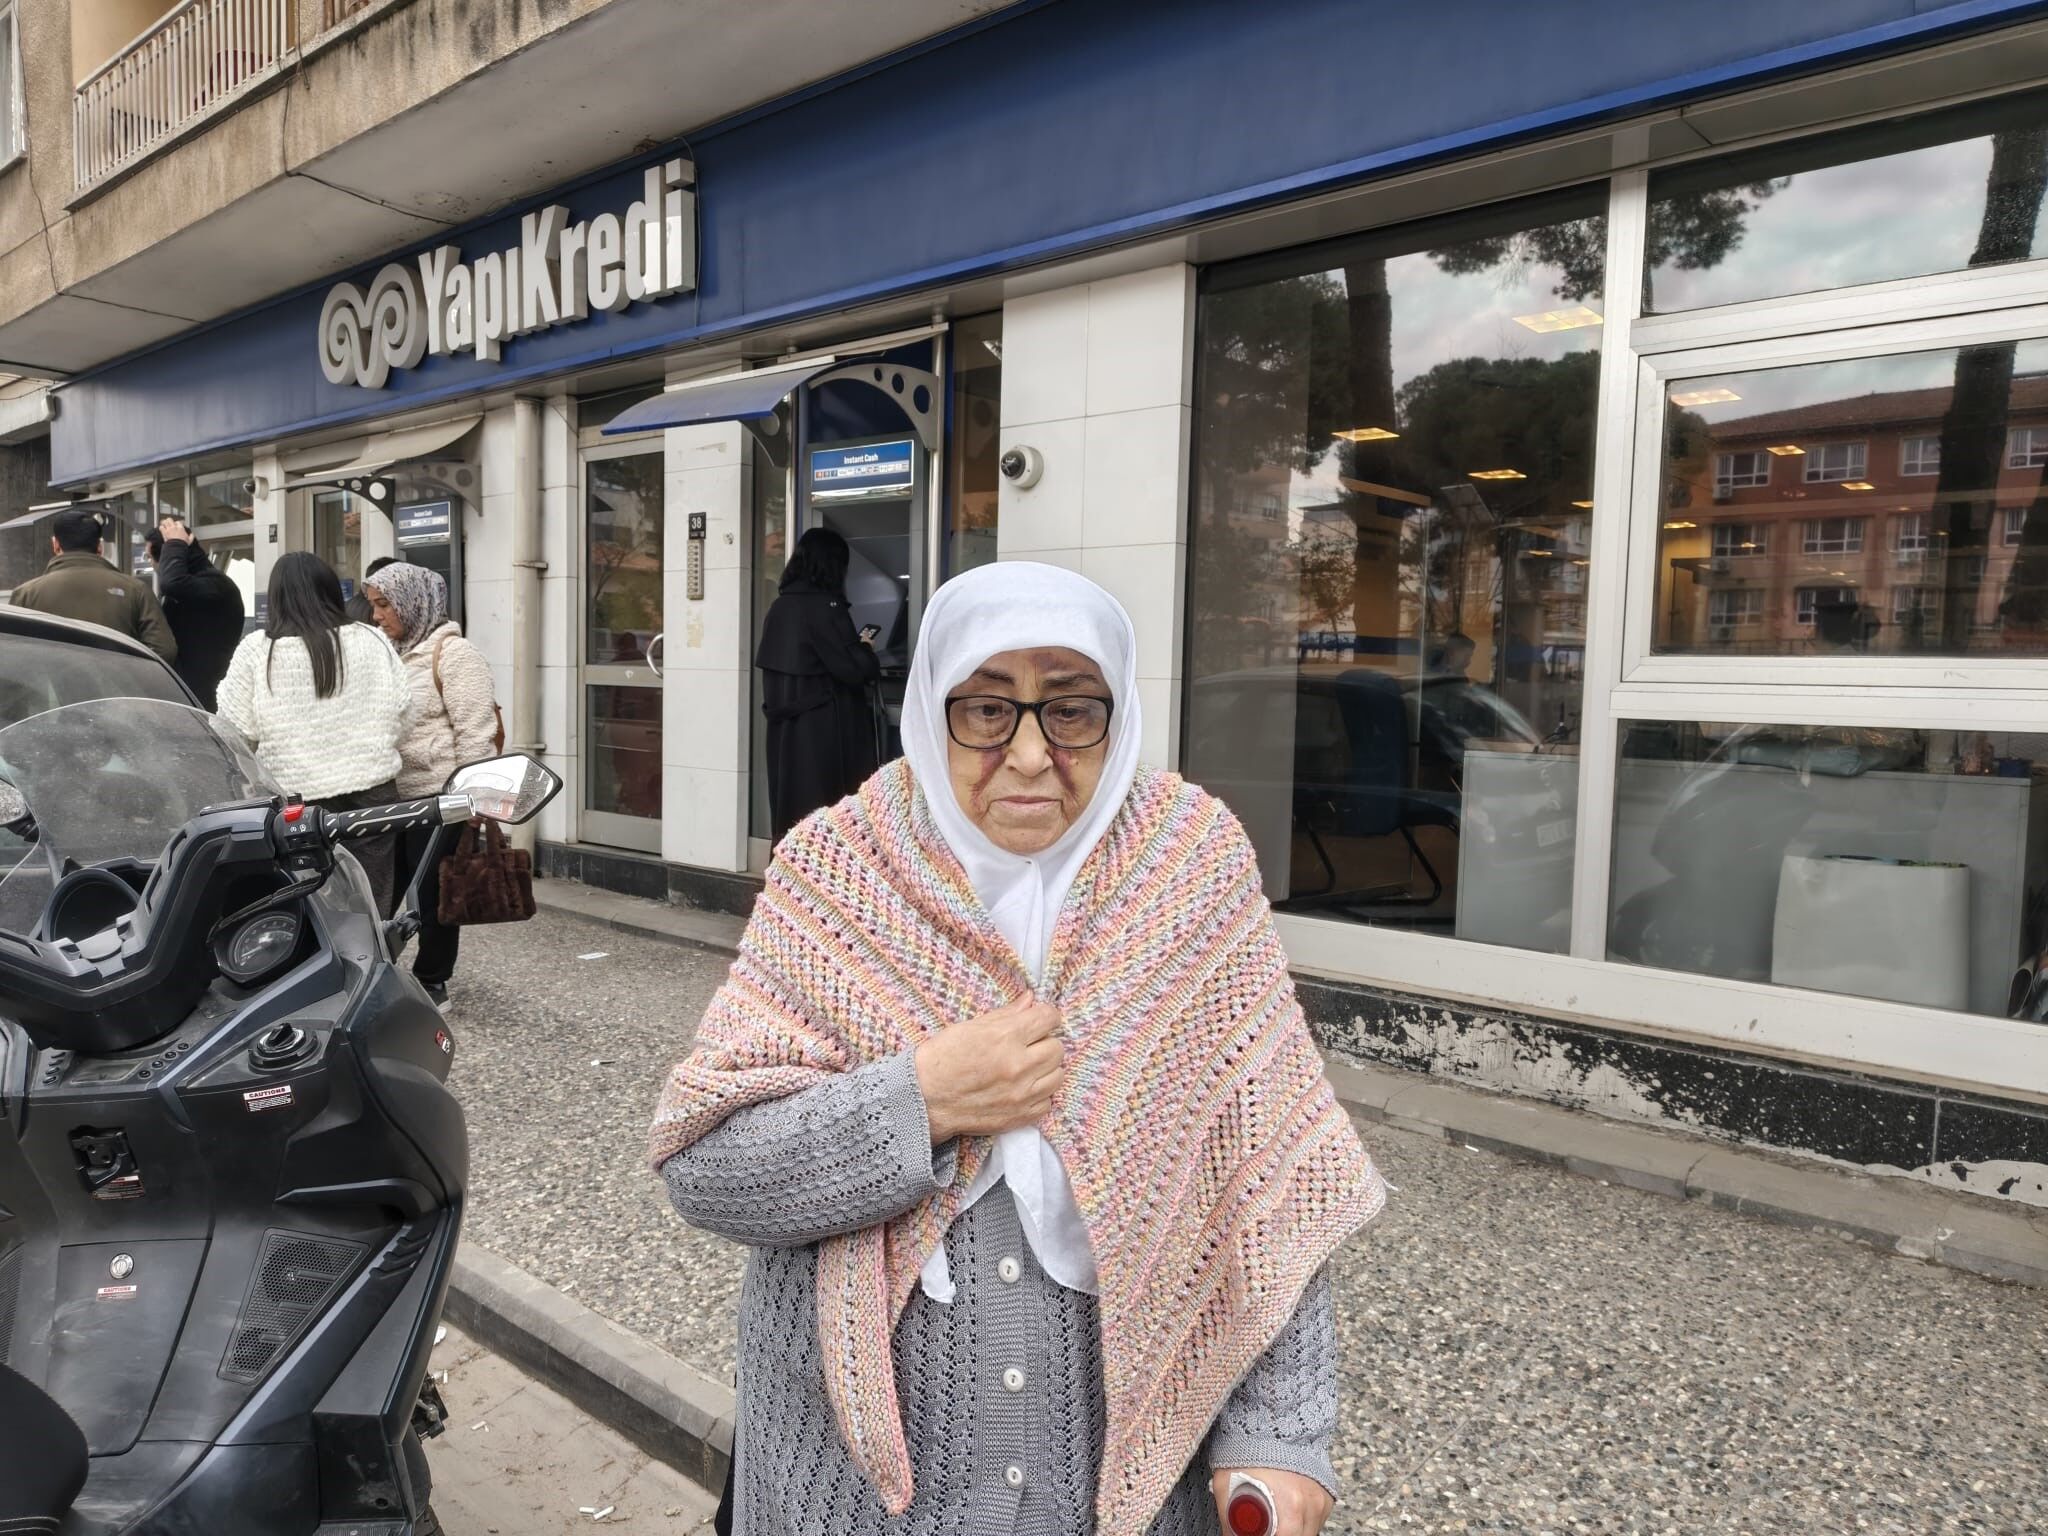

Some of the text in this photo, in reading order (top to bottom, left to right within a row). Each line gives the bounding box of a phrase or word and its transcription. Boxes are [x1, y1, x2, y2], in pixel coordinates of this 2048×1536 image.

[418, 157, 696, 362] YapıKredi
[843, 453, 879, 465] Instant Cash
[691, 516, 702, 530] 38
